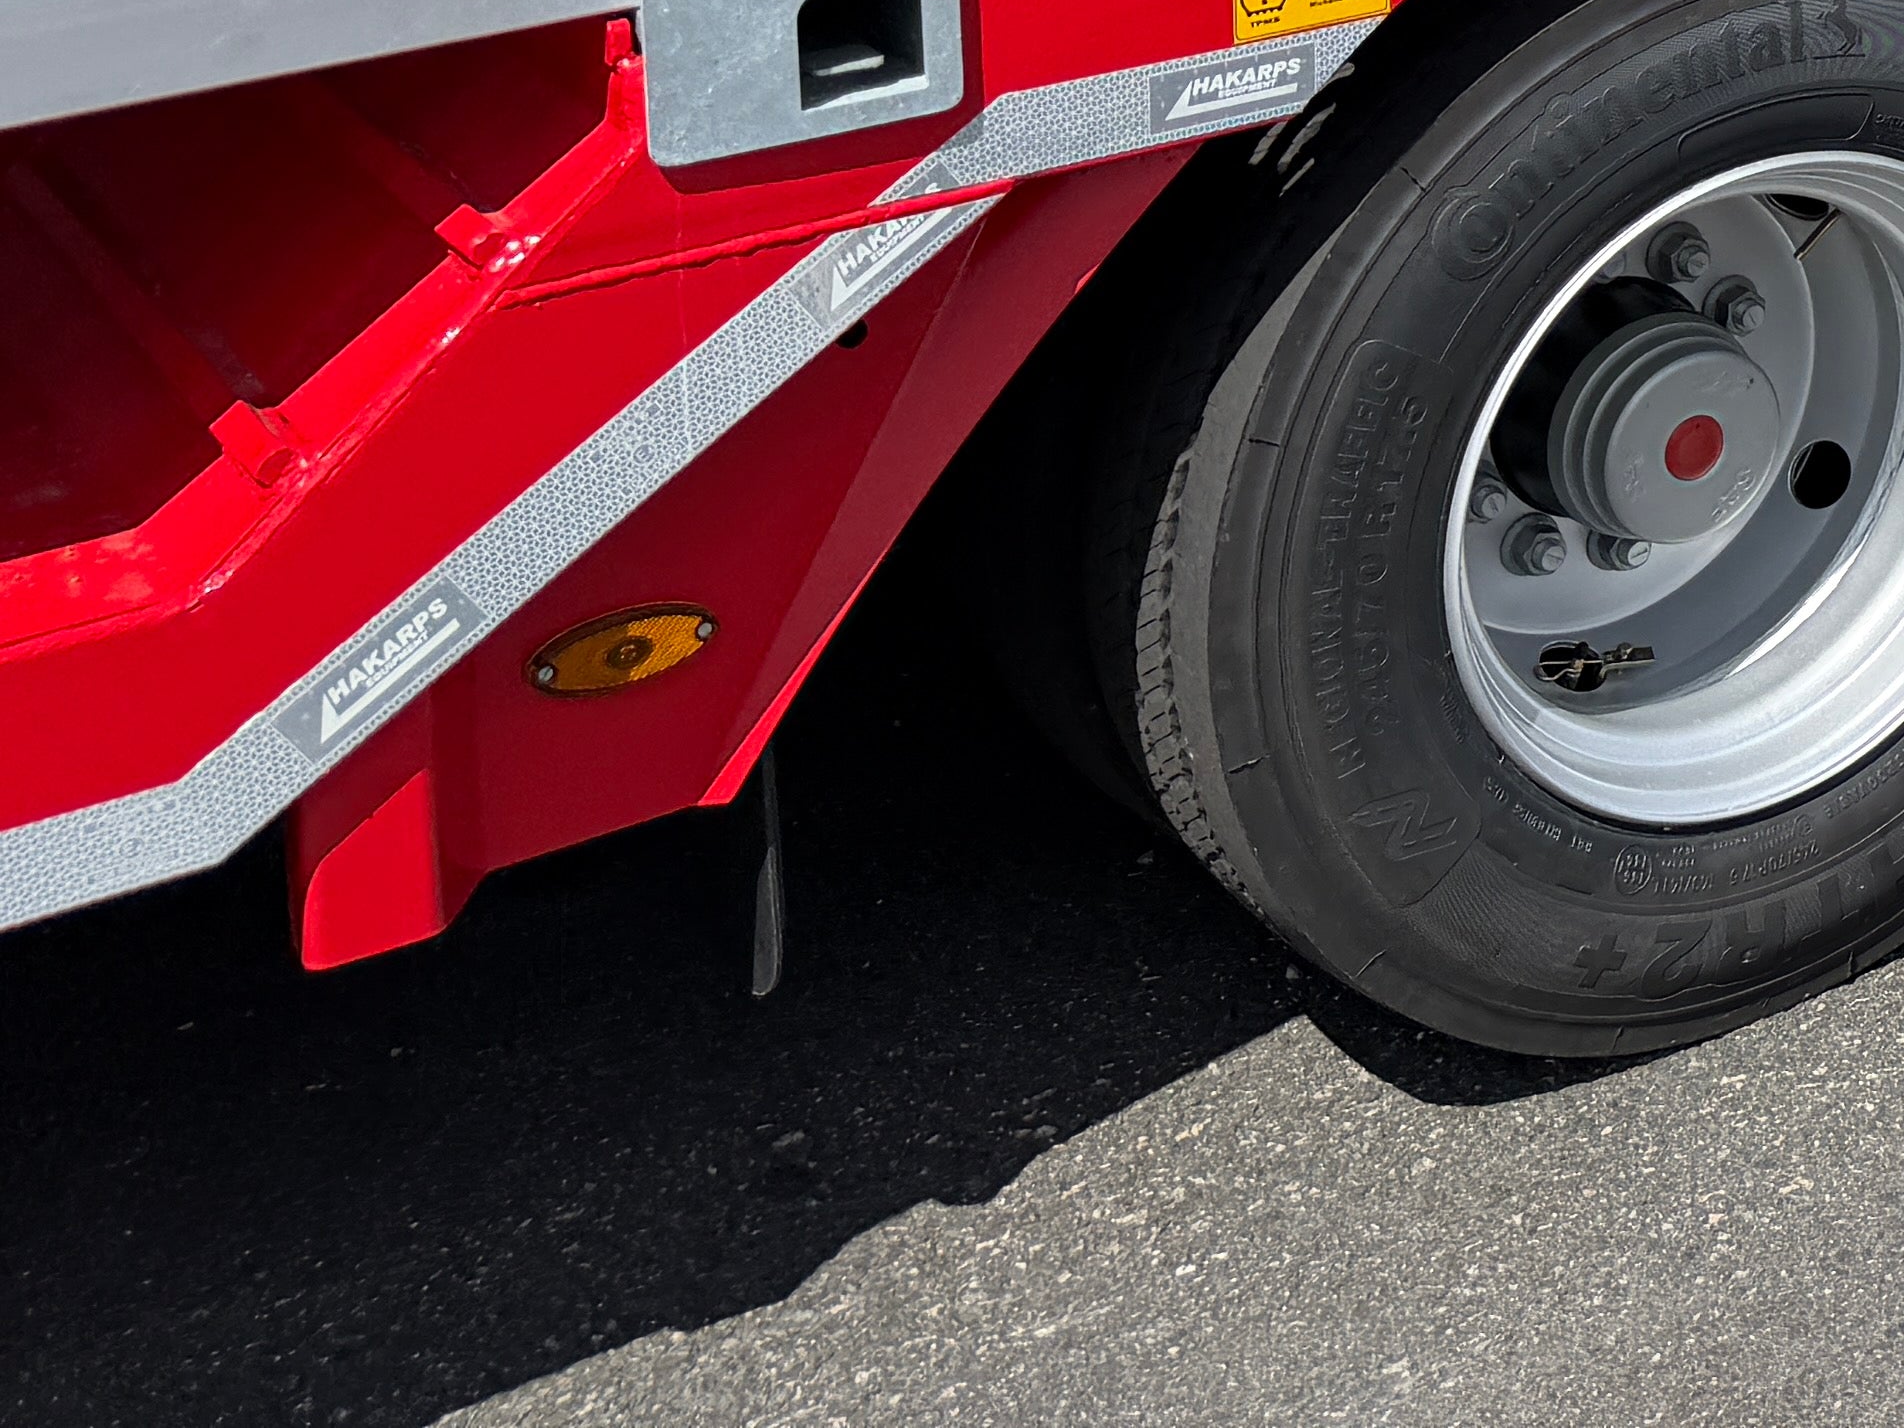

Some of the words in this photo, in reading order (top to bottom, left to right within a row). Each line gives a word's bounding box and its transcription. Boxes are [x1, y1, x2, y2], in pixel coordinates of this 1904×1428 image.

[1191, 57, 1302, 97] HAKARPS
[1310, 356, 1402, 781] REGIONAL-TRAFFIC
[326, 595, 449, 706] HAKARPS
